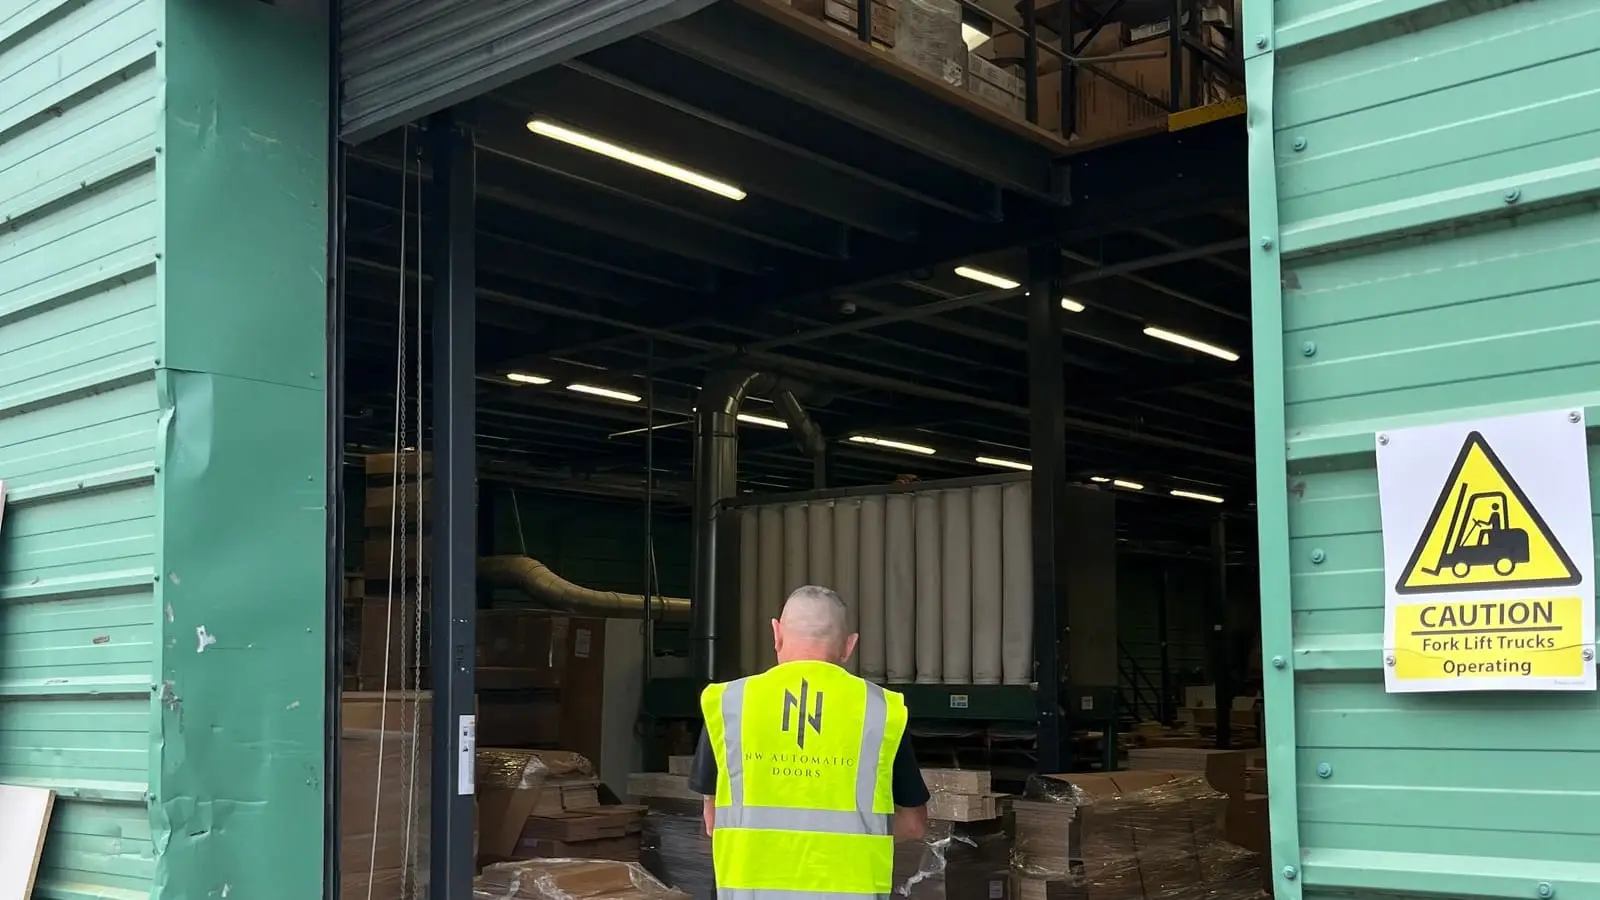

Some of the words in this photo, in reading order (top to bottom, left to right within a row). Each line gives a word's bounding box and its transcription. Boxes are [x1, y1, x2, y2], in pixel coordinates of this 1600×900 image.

[1420, 601, 1553, 628] CAUTION
[1422, 637, 1460, 652] Fork
[1464, 636, 1493, 651] Lift
[1497, 633, 1555, 650] Trucks
[1443, 658, 1532, 677] Operating
[745, 752, 763, 761] NW
[771, 753, 857, 767] AUTOMATIC
[772, 767, 821, 778] DOORS
